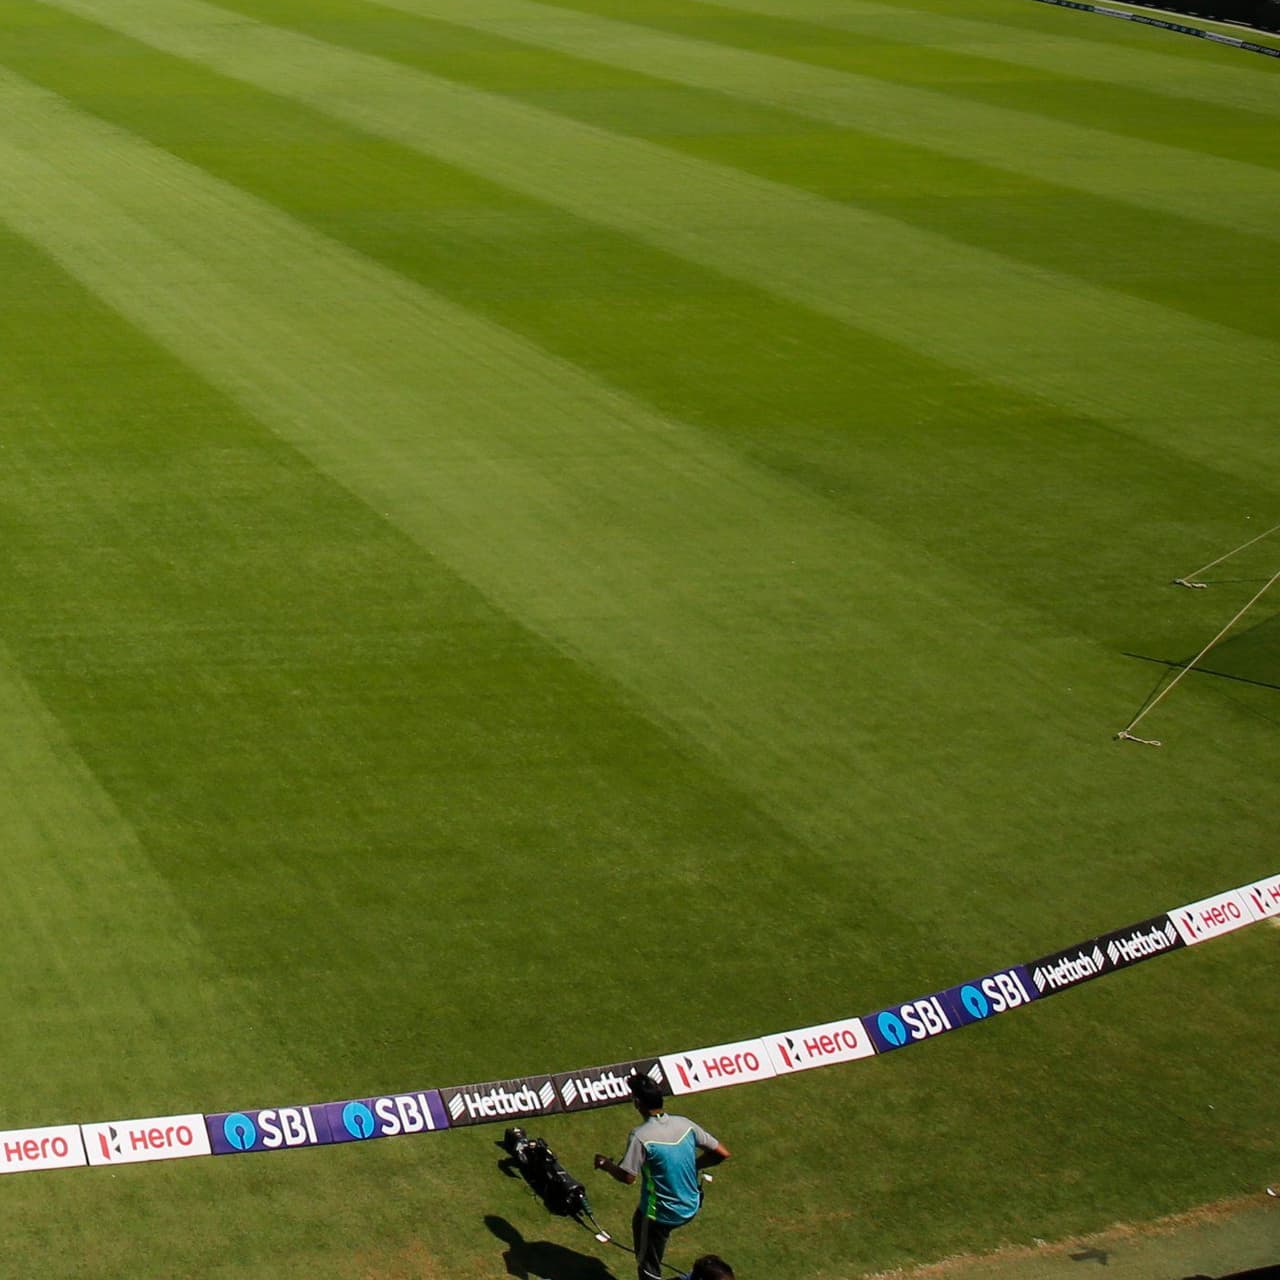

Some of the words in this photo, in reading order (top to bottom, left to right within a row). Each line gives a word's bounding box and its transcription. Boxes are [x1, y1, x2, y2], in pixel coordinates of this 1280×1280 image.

[1201, 899, 1242, 929] Hero
[1115, 925, 1168, 963] Hettich
[1044, 954, 1097, 988] Hettich
[982, 970, 1031, 1014] SBI
[901, 996, 952, 1042] SBI
[804, 1029, 858, 1059] Hero
[703, 1050, 760, 1078] Hero
[376, 1095, 434, 1136] SBI
[464, 1085, 541, 1119] Hettich
[130, 1125, 194, 1151] Hero
[259, 1108, 318, 1150] SBI
[5, 1137, 68, 1163] Hero
